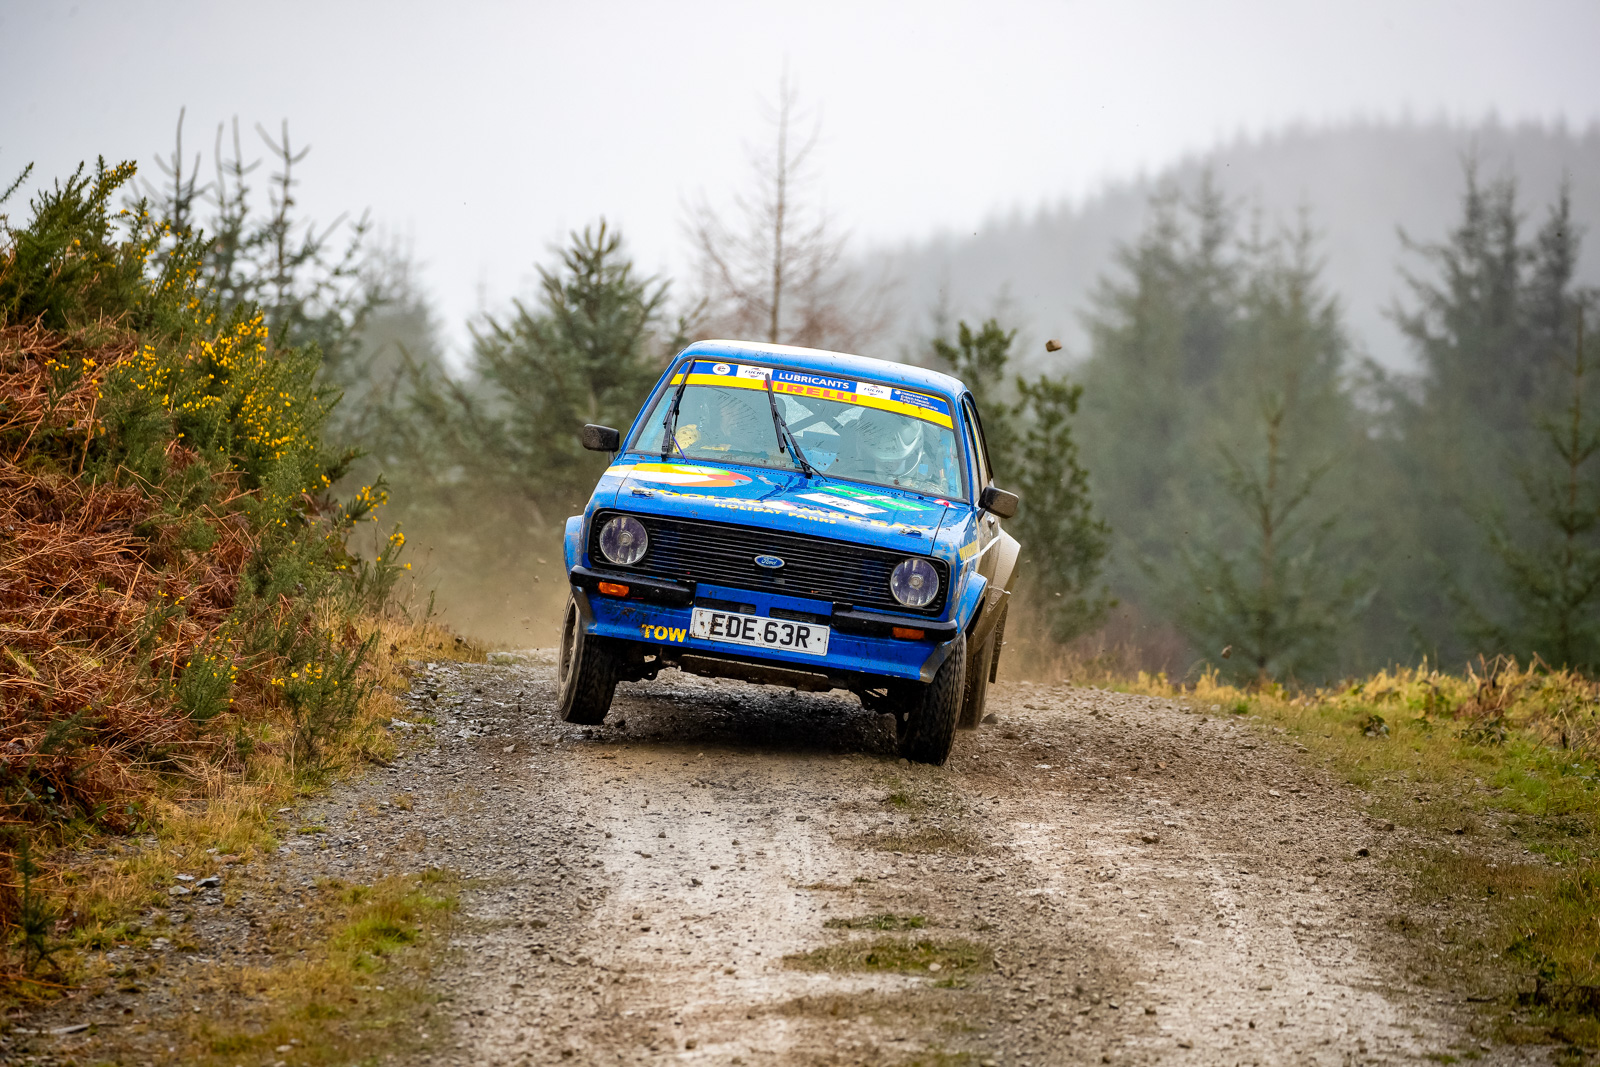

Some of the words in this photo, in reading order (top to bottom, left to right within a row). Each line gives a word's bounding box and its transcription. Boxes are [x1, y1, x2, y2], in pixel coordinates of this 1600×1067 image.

[778, 373, 849, 389] LUBRICANTS
[714, 503, 782, 515] HOLIDAY
[788, 512, 837, 524] PARKS
[761, 556, 778, 566] Ford
[641, 623, 687, 643] TOW
[710, 613, 758, 641] EDE
[763, 621, 811, 649] 63R
